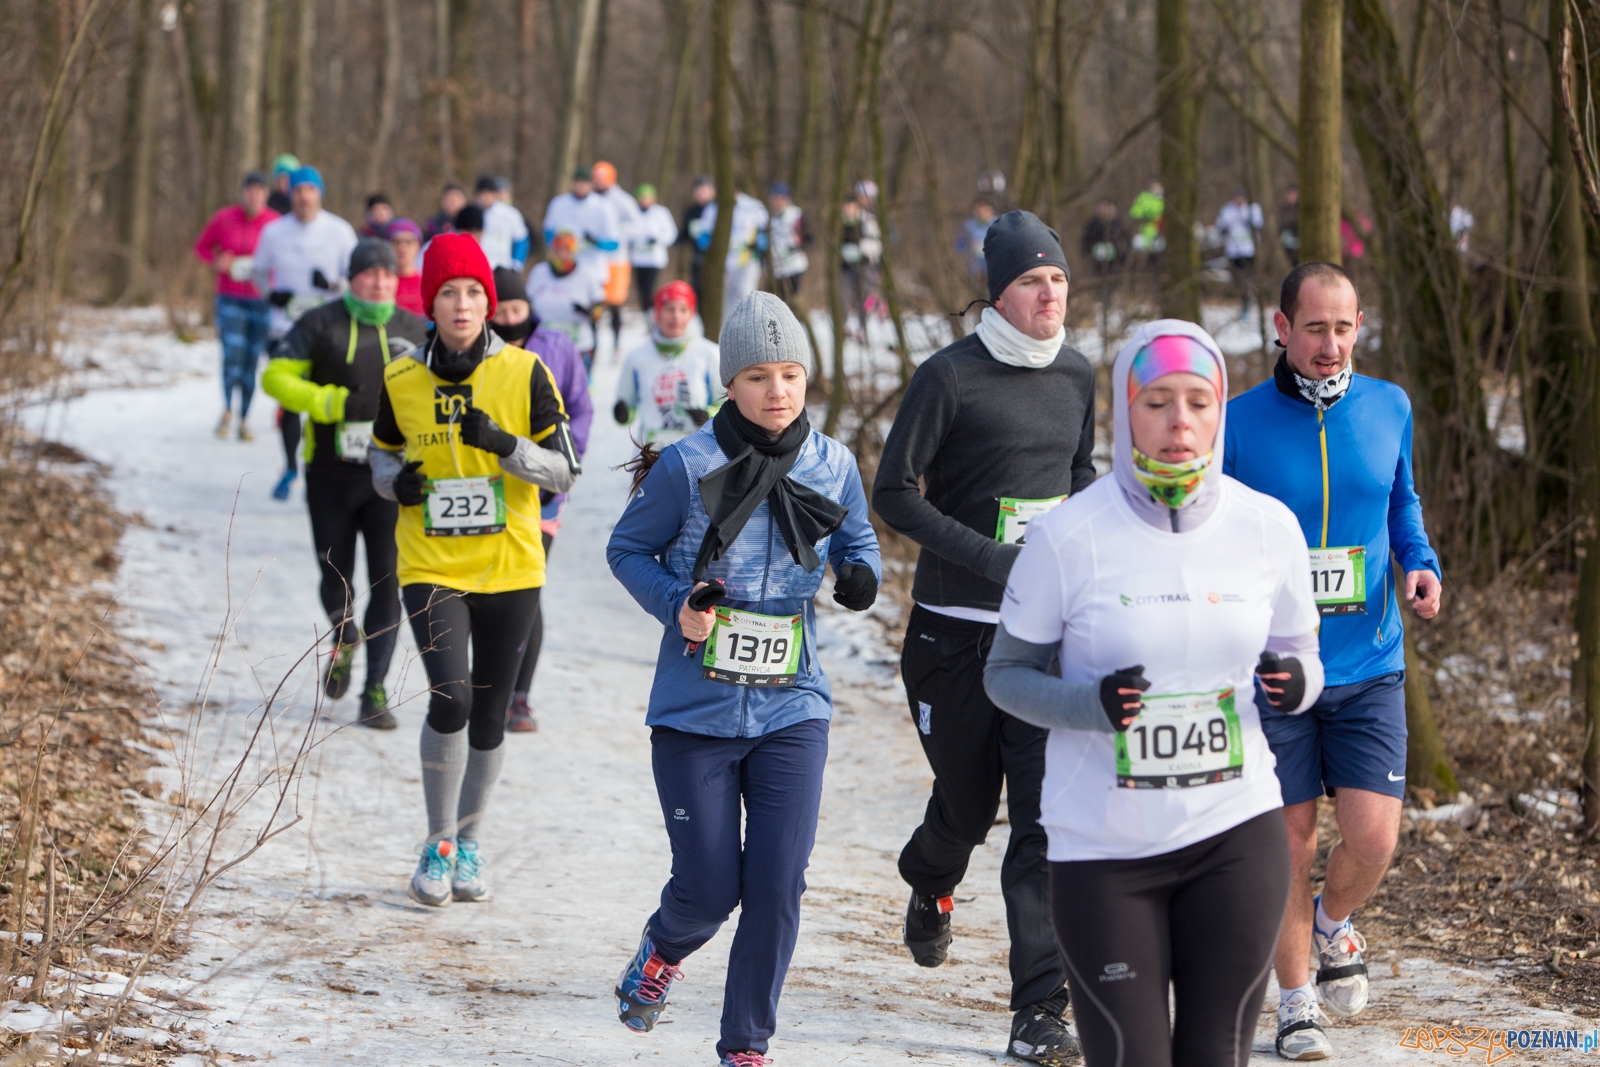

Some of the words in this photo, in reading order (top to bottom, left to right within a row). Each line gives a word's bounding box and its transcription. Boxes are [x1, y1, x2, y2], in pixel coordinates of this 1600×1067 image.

[440, 495, 488, 518] 232
[728, 632, 788, 664] 1319
[738, 664, 771, 673] PATRYCJA
[1133, 718, 1228, 760] 1048
